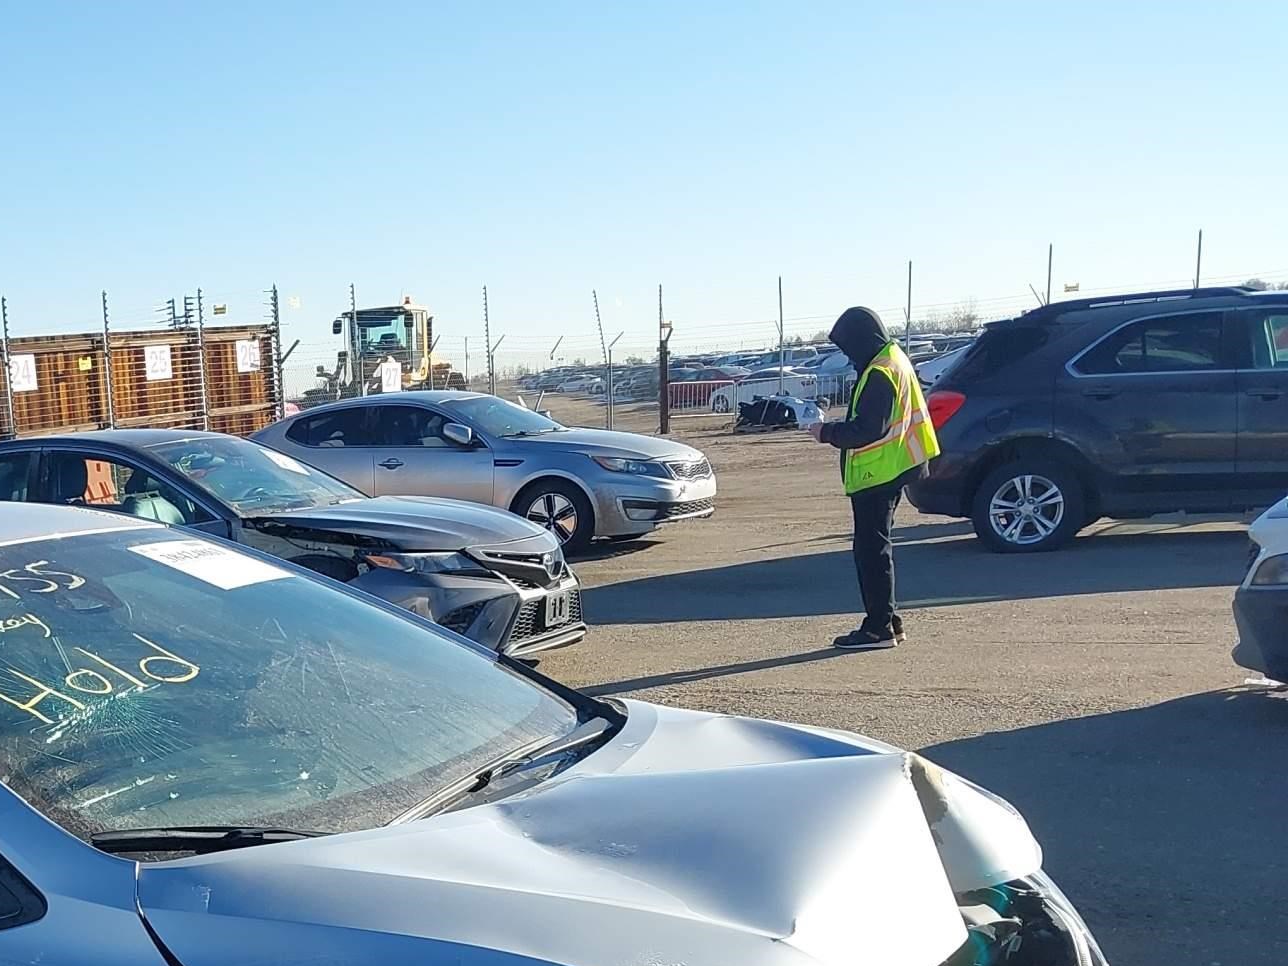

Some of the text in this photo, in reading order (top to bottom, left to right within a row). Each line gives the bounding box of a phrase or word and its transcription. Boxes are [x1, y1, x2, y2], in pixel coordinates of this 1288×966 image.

[11, 359, 32, 385] 24
[150, 350, 167, 373] 25
[385, 367, 399, 387] 27
